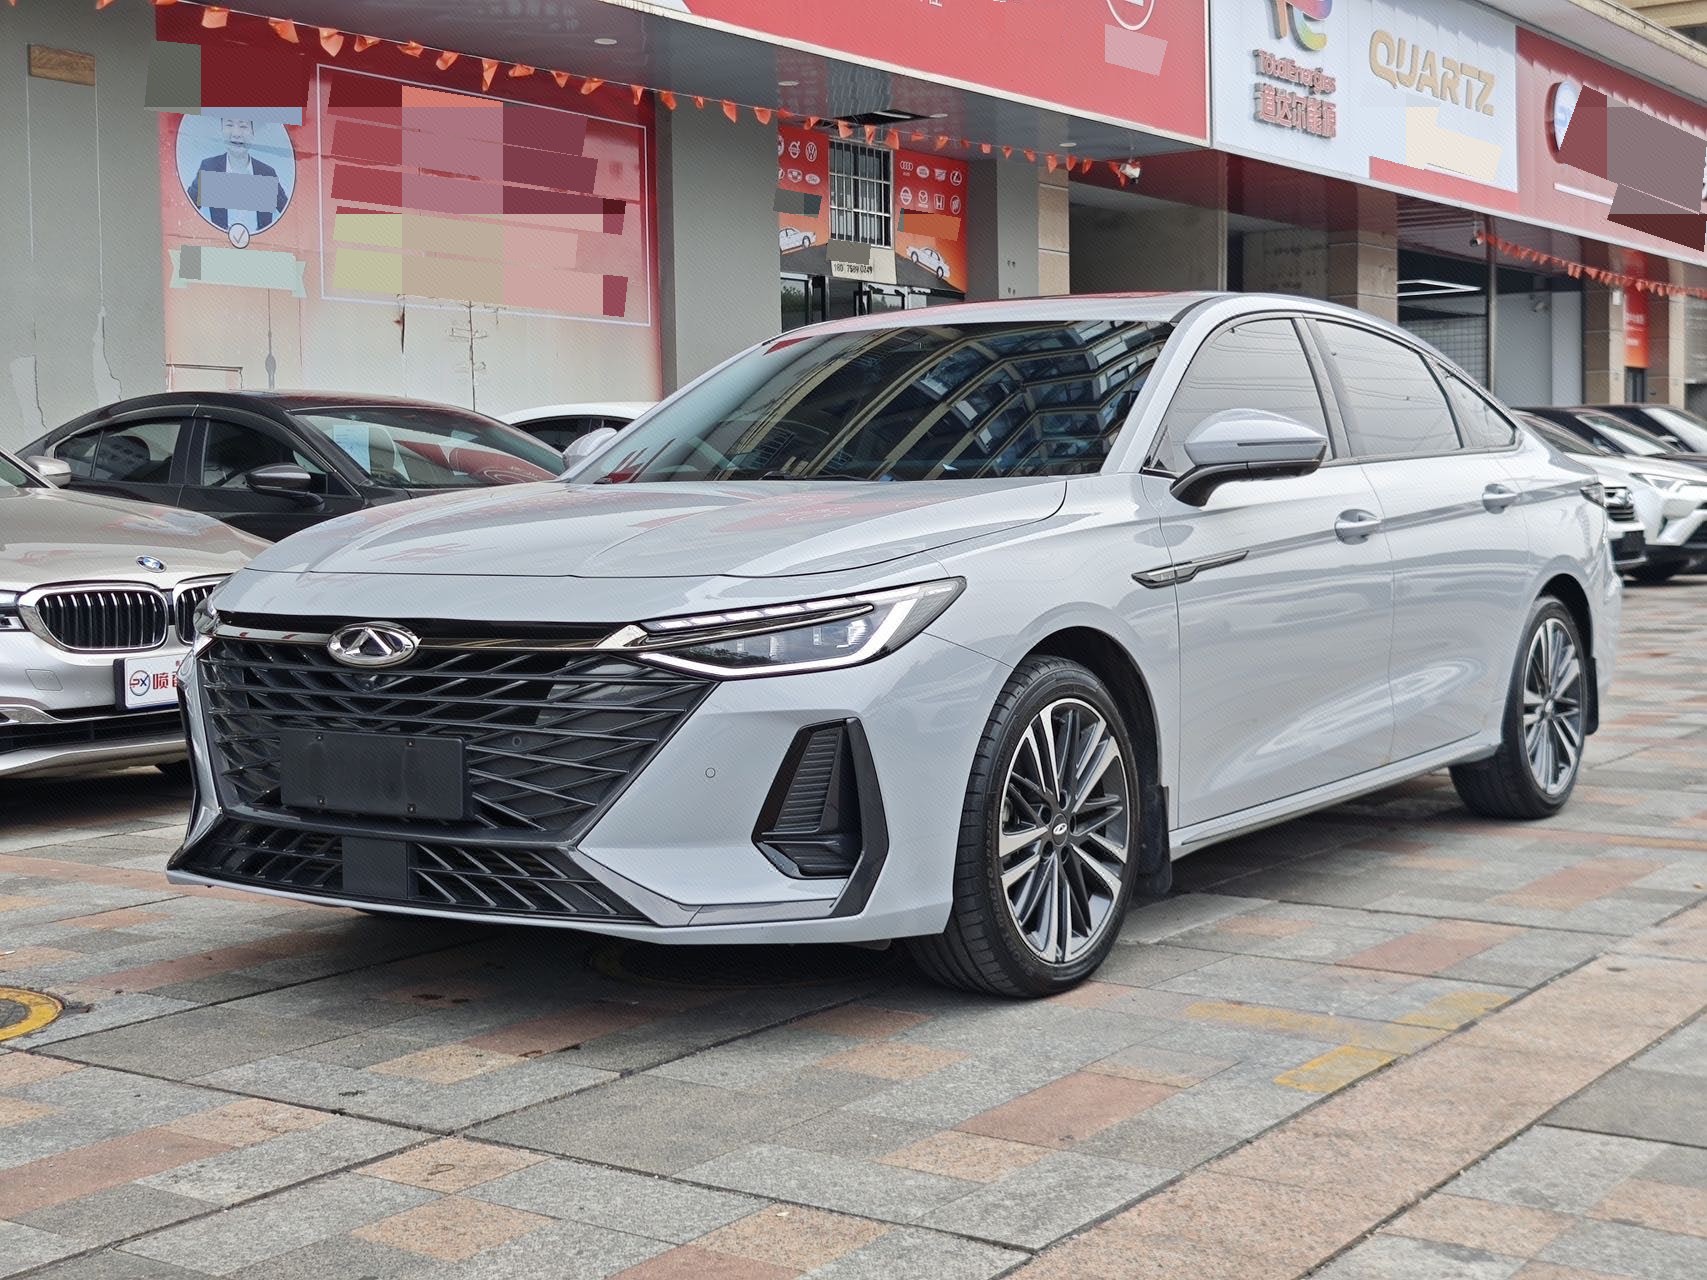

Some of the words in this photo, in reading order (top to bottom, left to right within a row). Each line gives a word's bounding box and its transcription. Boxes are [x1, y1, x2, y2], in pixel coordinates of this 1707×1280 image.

[1254, 49, 1336, 94] TotalEnergies
[1369, 29, 1495, 117] QUARTZ
[1255, 83, 1336, 138] 道达尔能源
